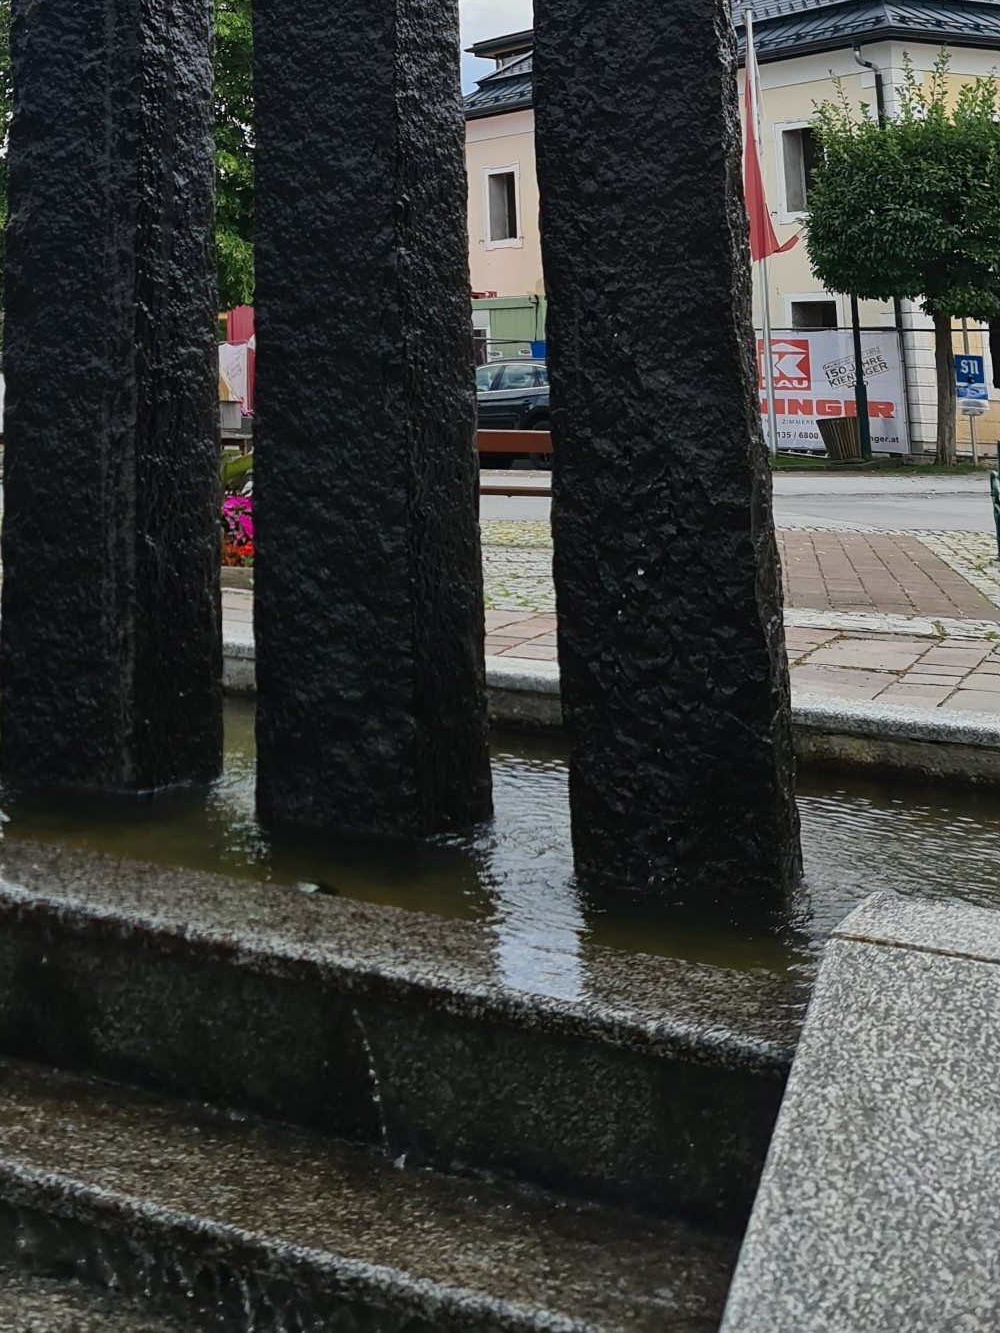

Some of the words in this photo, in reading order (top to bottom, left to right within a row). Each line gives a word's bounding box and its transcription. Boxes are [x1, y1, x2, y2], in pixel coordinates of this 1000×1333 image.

[825, 366, 847, 379] 150
[849, 354, 884, 372] JHRE
[828, 361, 889, 387] KIENGER
[798, 431, 819, 440] 6800
